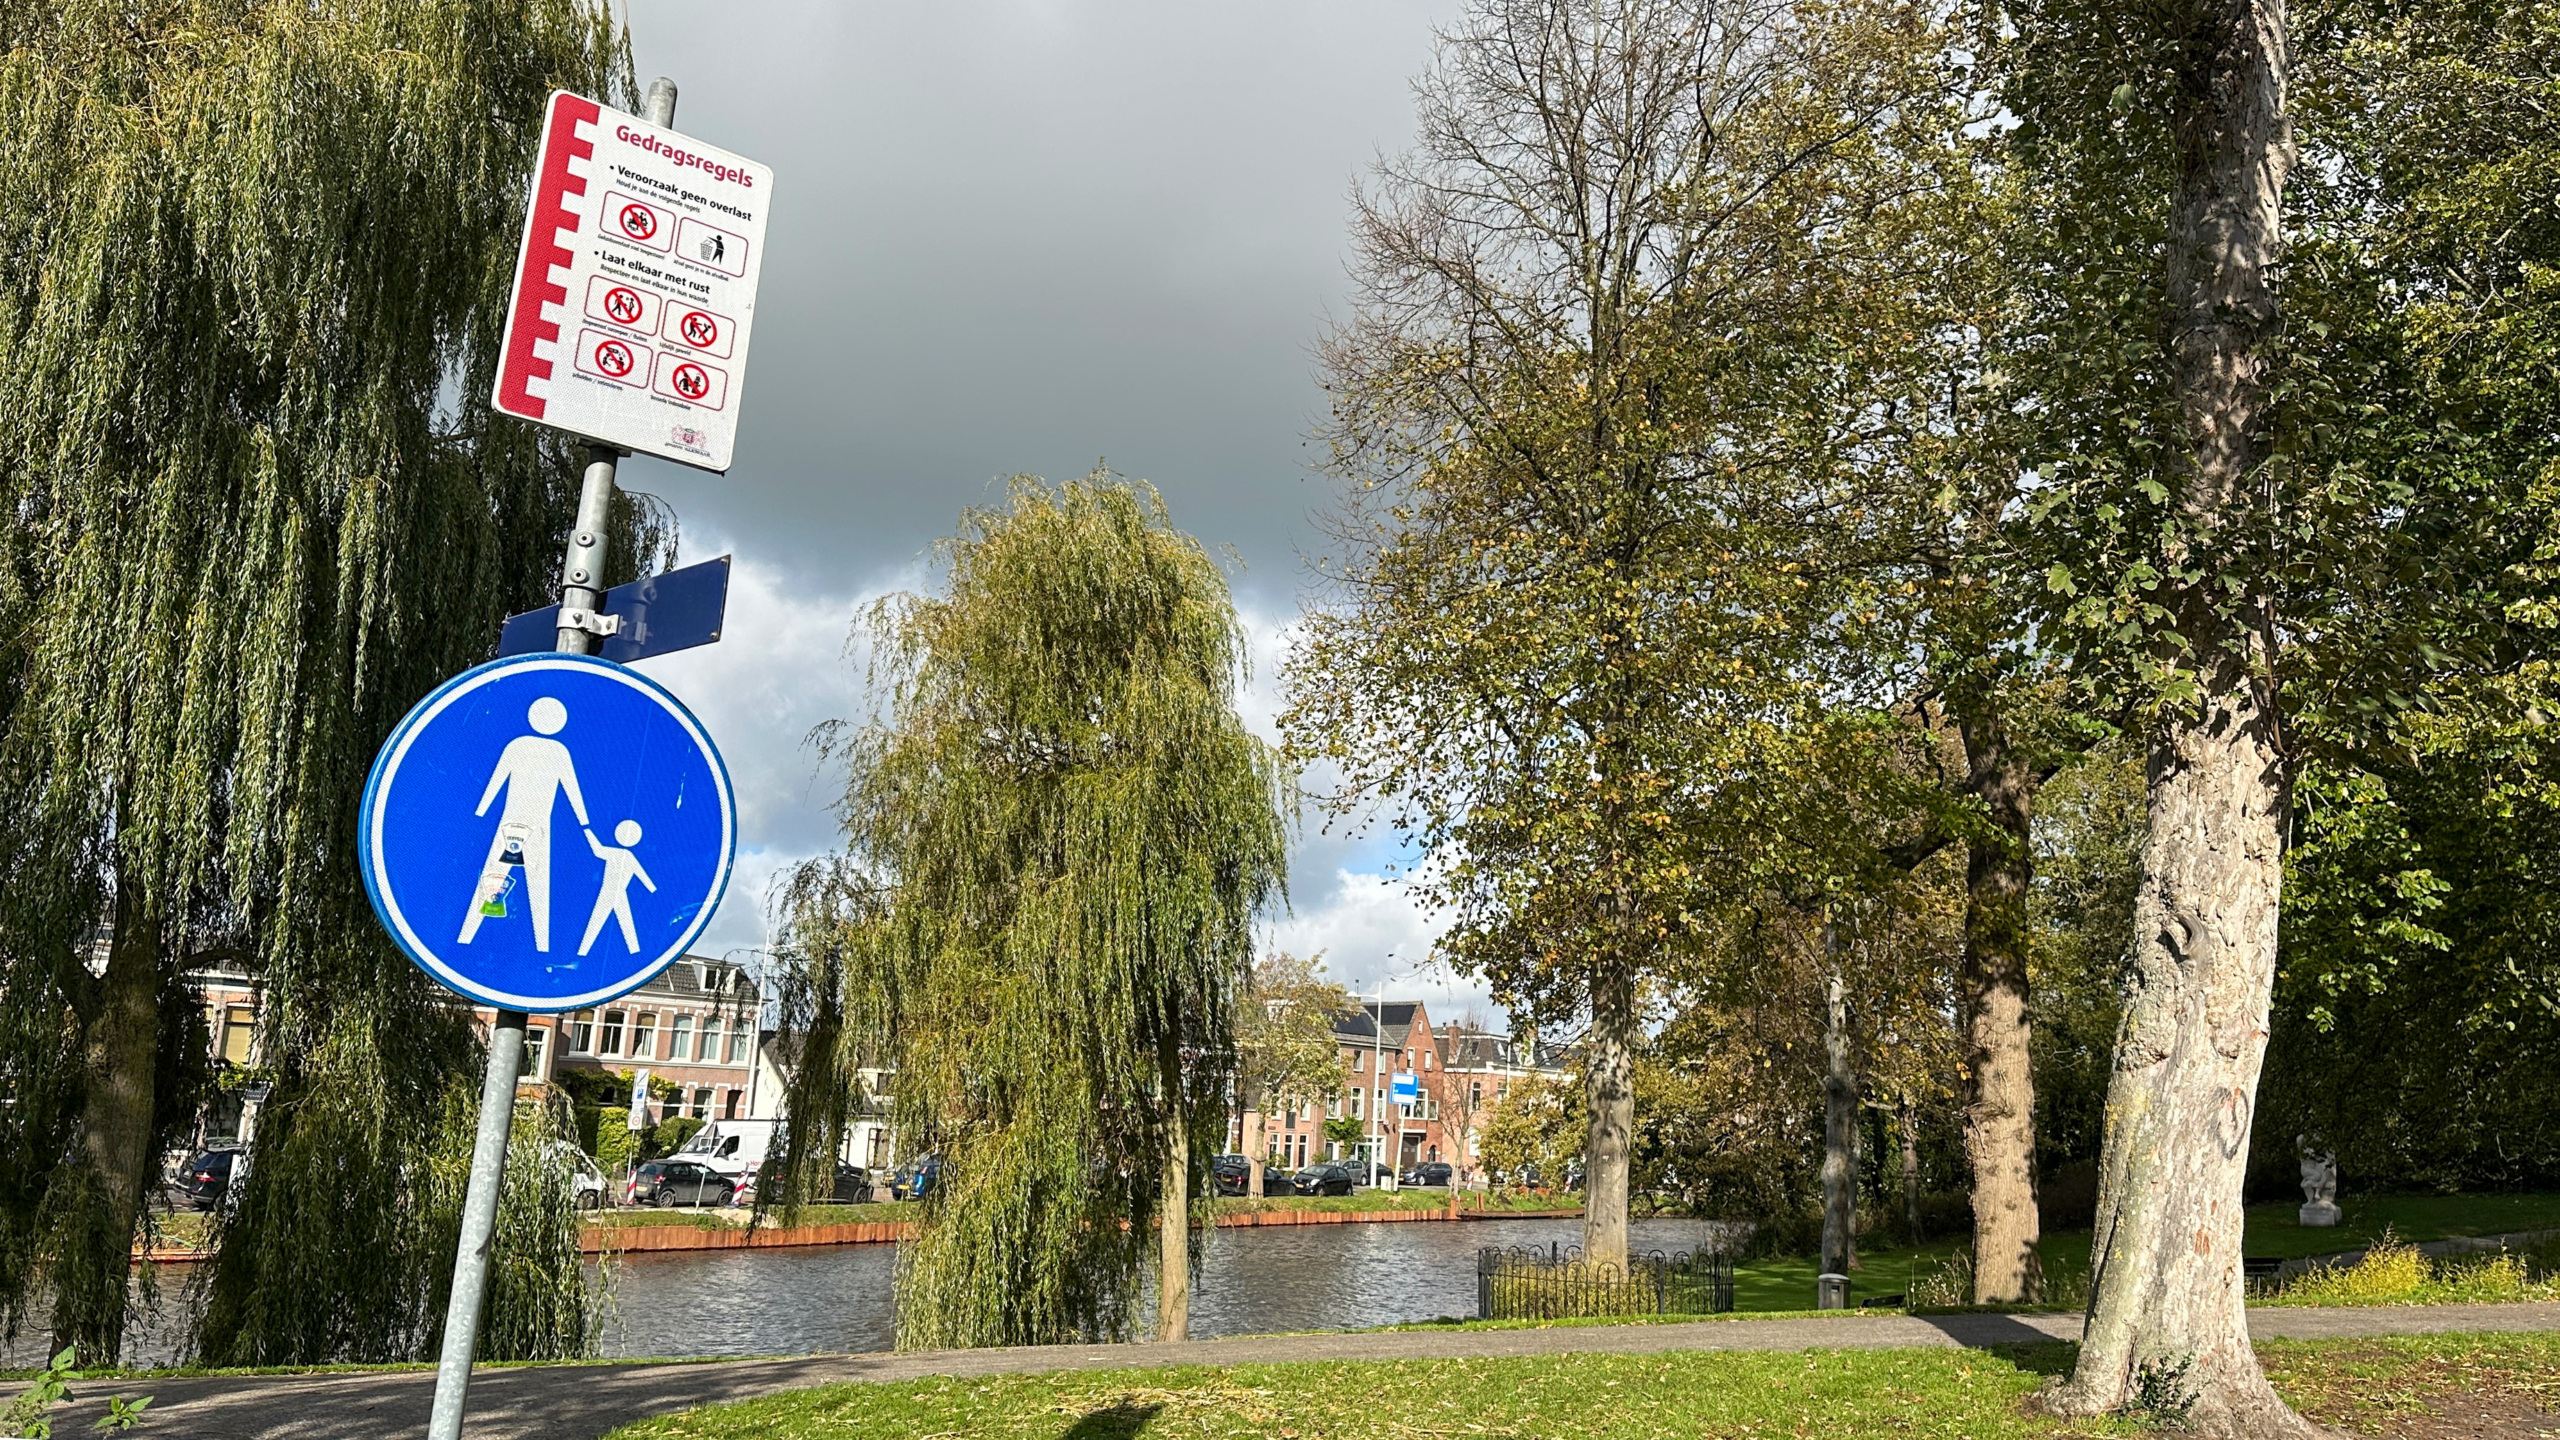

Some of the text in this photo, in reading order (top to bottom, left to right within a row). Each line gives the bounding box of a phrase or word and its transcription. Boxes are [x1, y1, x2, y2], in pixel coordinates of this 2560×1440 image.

[616, 125, 753, 188] Gedragsregels
[616, 178, 631, 189] Houd
[638, 187, 649, 195] aan
[658, 194, 685, 207] volgende
[684, 203, 700, 213] regels
[618, 165, 752, 221] Veroorzaak geen overlast
[600, 263, 631, 278] Respecteer
[640, 277, 651, 285] laat
[651, 281, 669, 291] elkaar
[676, 289, 687, 297] hun
[688, 293, 708, 304] waarde
[602, 250, 710, 294] Laat elkaar met rust
